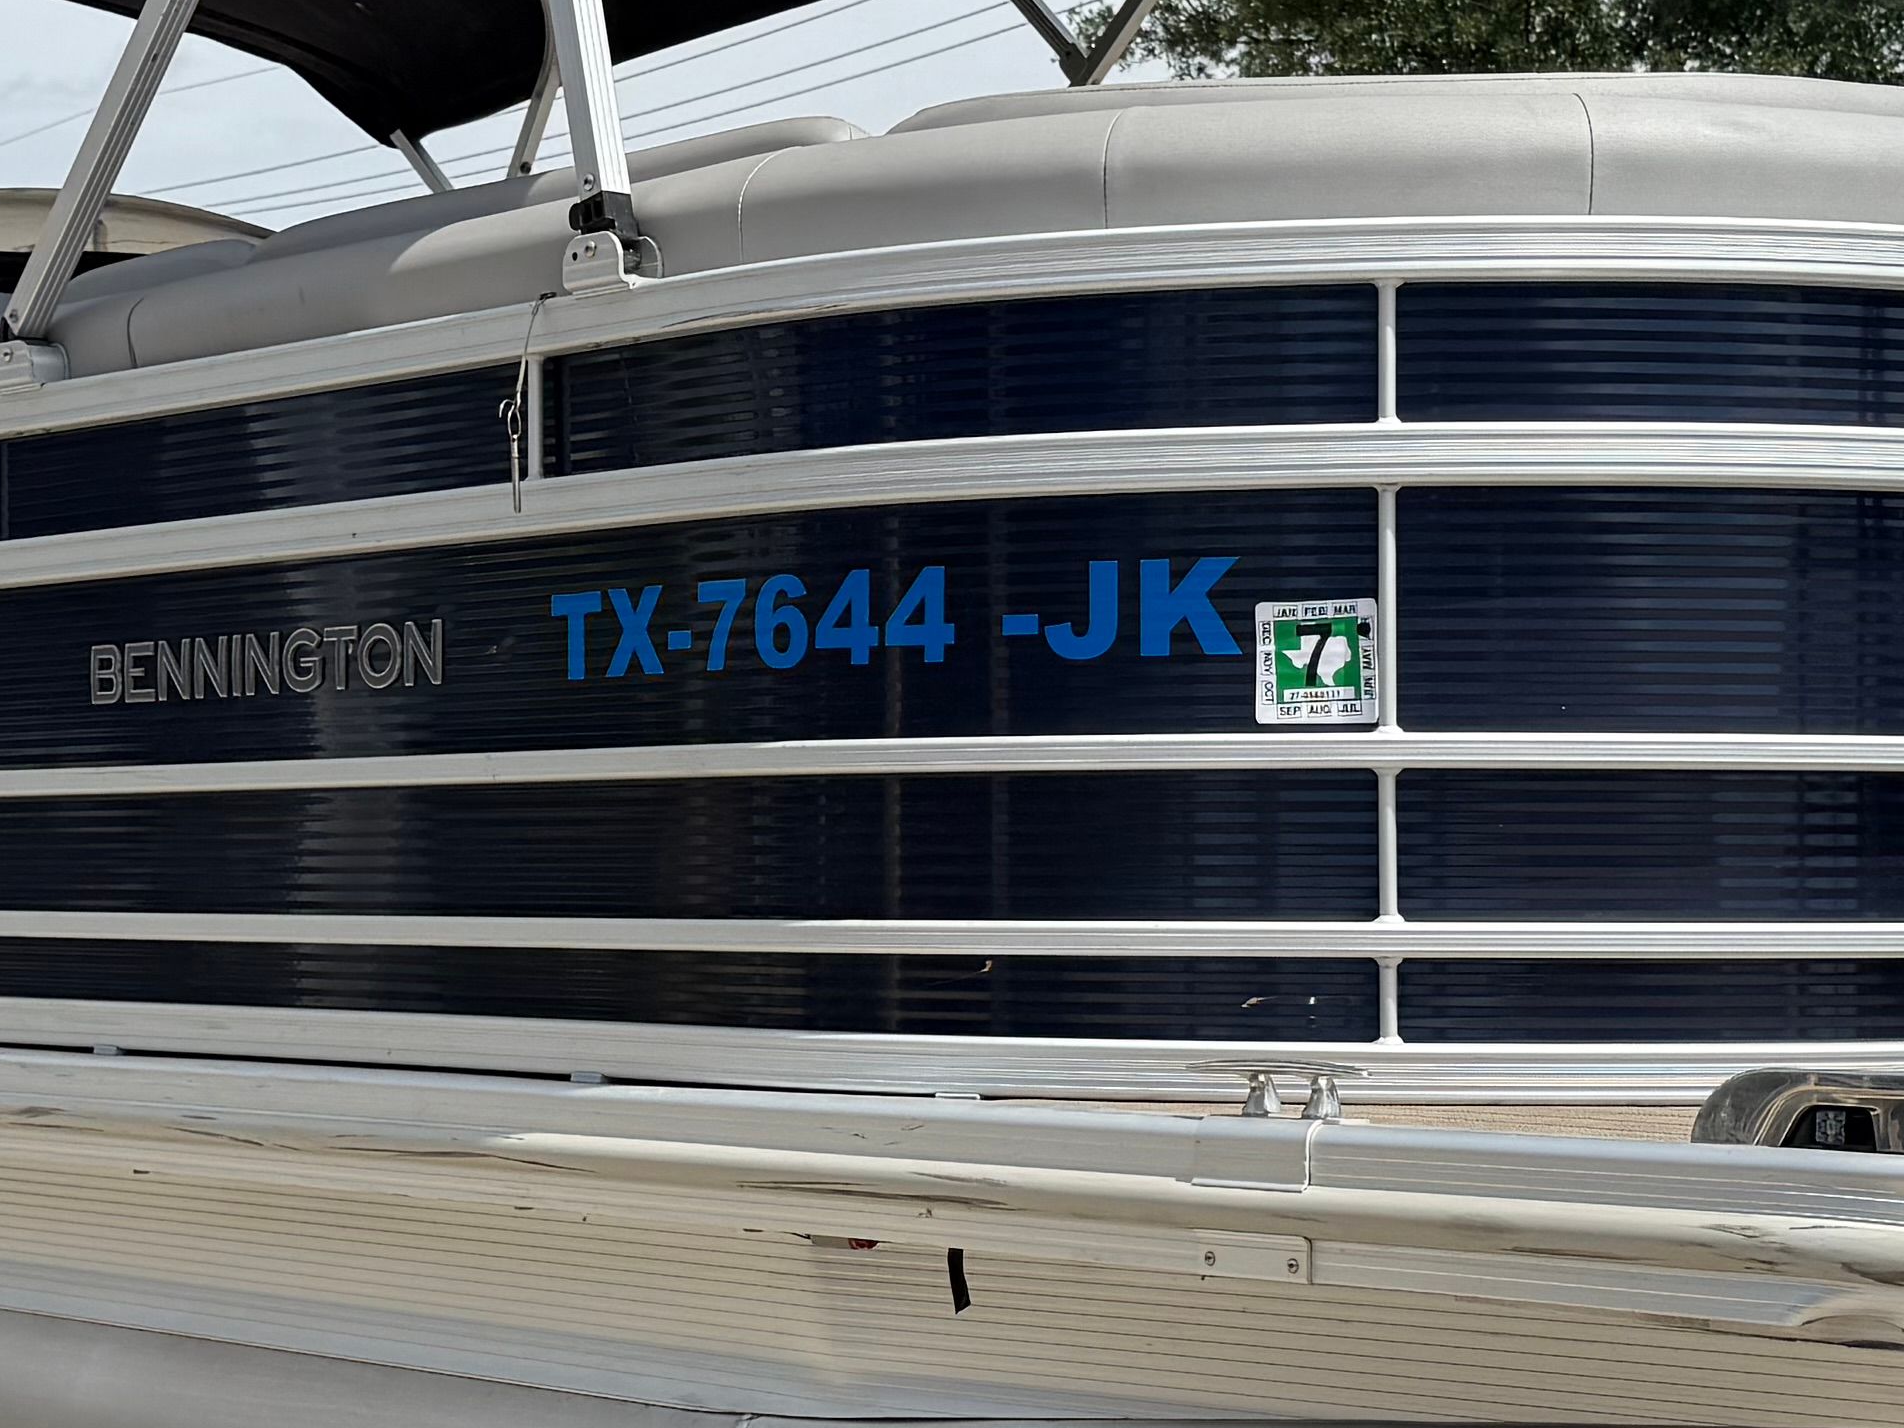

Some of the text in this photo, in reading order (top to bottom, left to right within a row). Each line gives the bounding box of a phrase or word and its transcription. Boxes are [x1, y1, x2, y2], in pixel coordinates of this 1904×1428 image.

[551, 556, 1244, 679] TX-7644 -JK
[1296, 624, 1332, 686] 7
[91, 619, 444, 705] BENNINGTON
